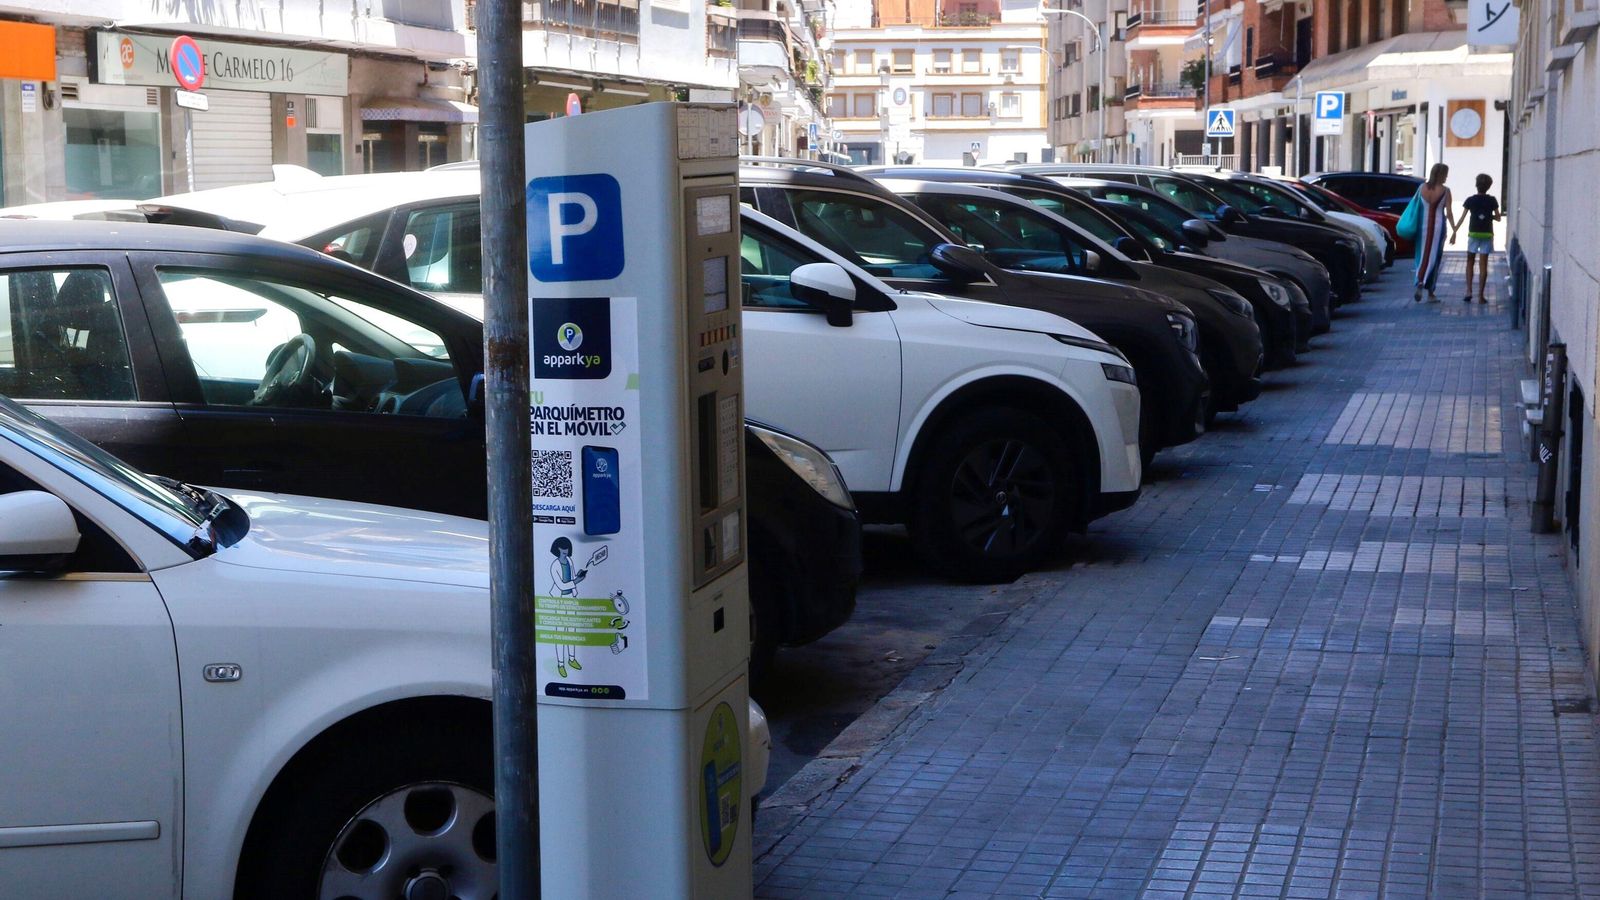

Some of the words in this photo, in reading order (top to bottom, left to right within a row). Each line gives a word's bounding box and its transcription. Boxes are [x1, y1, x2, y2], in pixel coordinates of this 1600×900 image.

[213, 51, 276, 81] CARMELO
[280, 58, 294, 82] 16
[1321, 95, 1339, 117] P
[547, 191, 598, 265] P
[543, 353, 601, 368] apparkya
[530, 404, 625, 421] PARQUÍMETRO
[547, 422, 562, 436] EL
[565, 420, 612, 436] MÓVIL
[562, 505, 576, 513] AQUÍ
